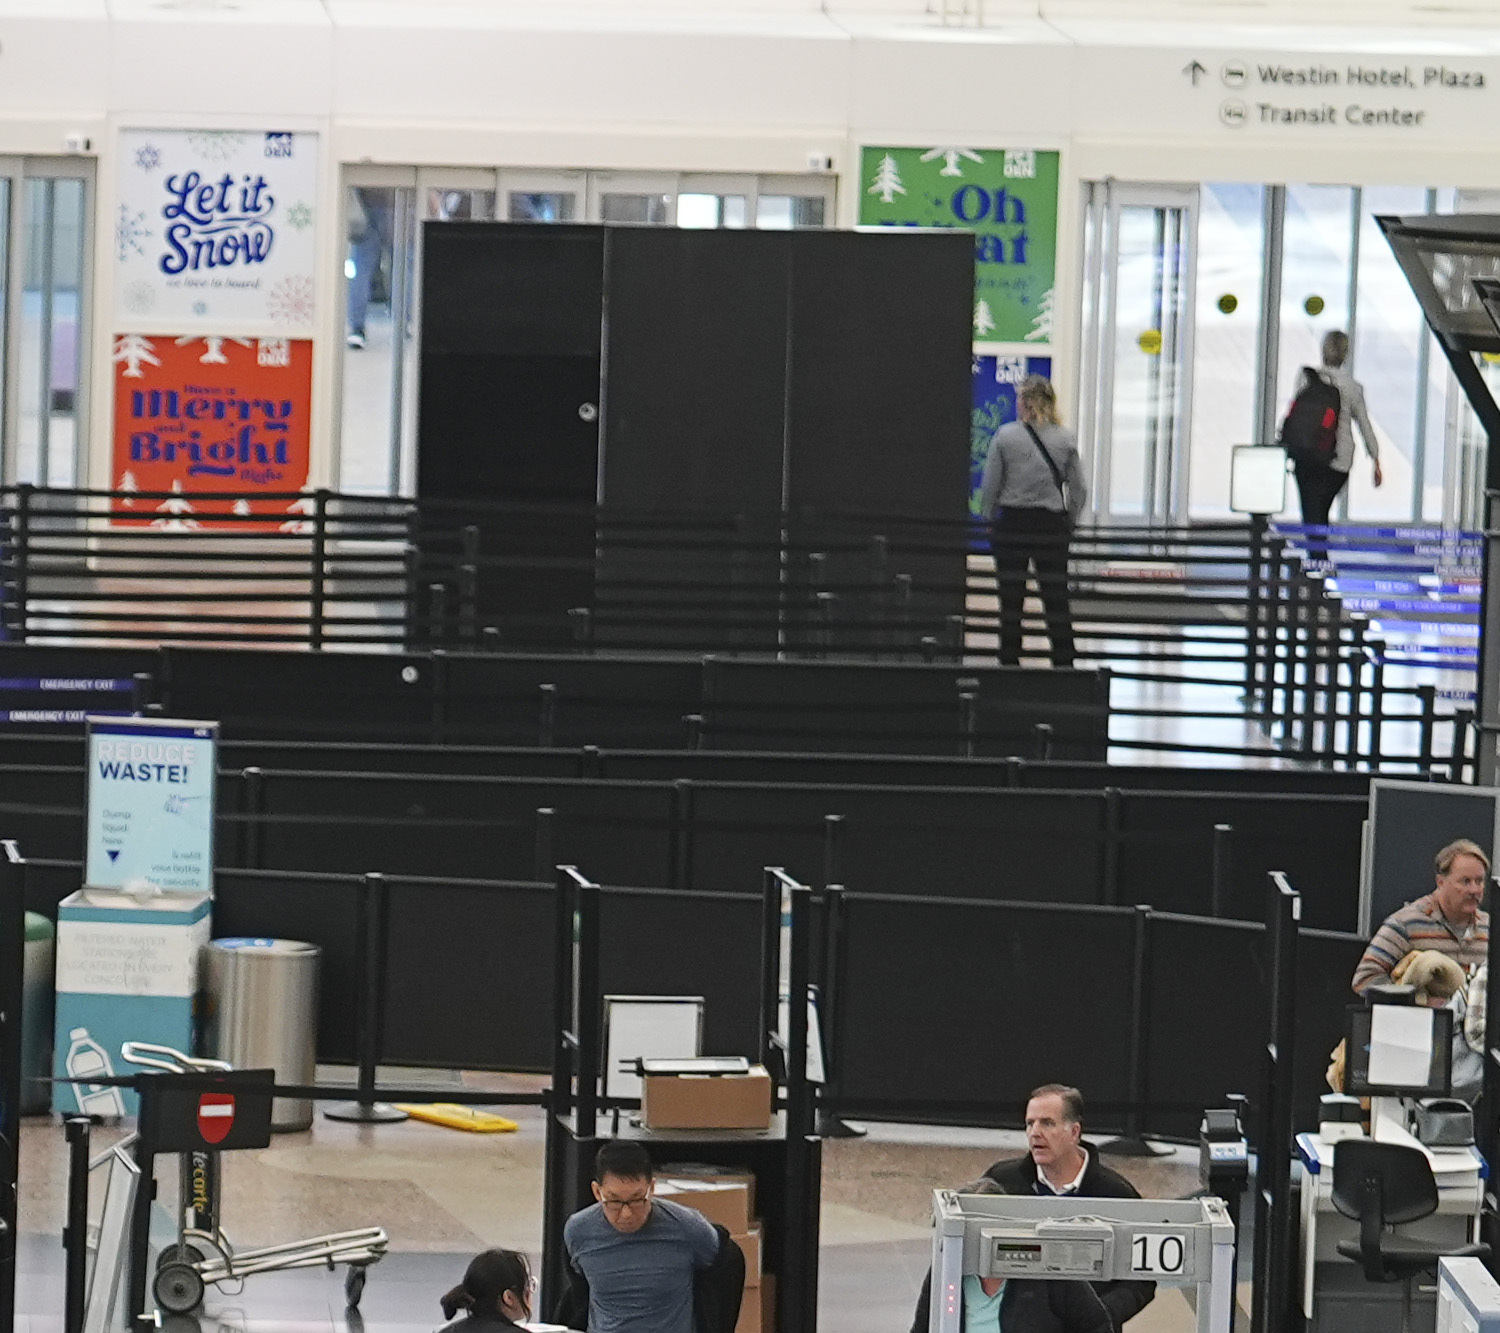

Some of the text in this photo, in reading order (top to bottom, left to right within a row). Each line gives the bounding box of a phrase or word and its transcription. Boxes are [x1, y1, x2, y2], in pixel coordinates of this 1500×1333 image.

[1258, 66, 1486, 89] Westin Hotel, Plaza
[1258, 105, 1426, 126] Transit Center
[264, 148, 291, 158] DEN
[1003, 166, 1036, 178] DEN
[163, 172, 231, 221] Let
[949, 183, 1025, 223] Oh
[159, 222, 273, 275] Snow
[258, 354, 291, 368] DEN
[130, 388, 294, 434] Merry
[130, 423, 291, 478] Bright
[40, 679, 114, 691] EMERGENCY EXIT
[10, 711, 85, 723] EMERGENCY EXIT
[97, 743, 197, 764] REDUCE
[99, 762, 188, 784] WASTE!
[1133, 1236, 1183, 1273] 10
